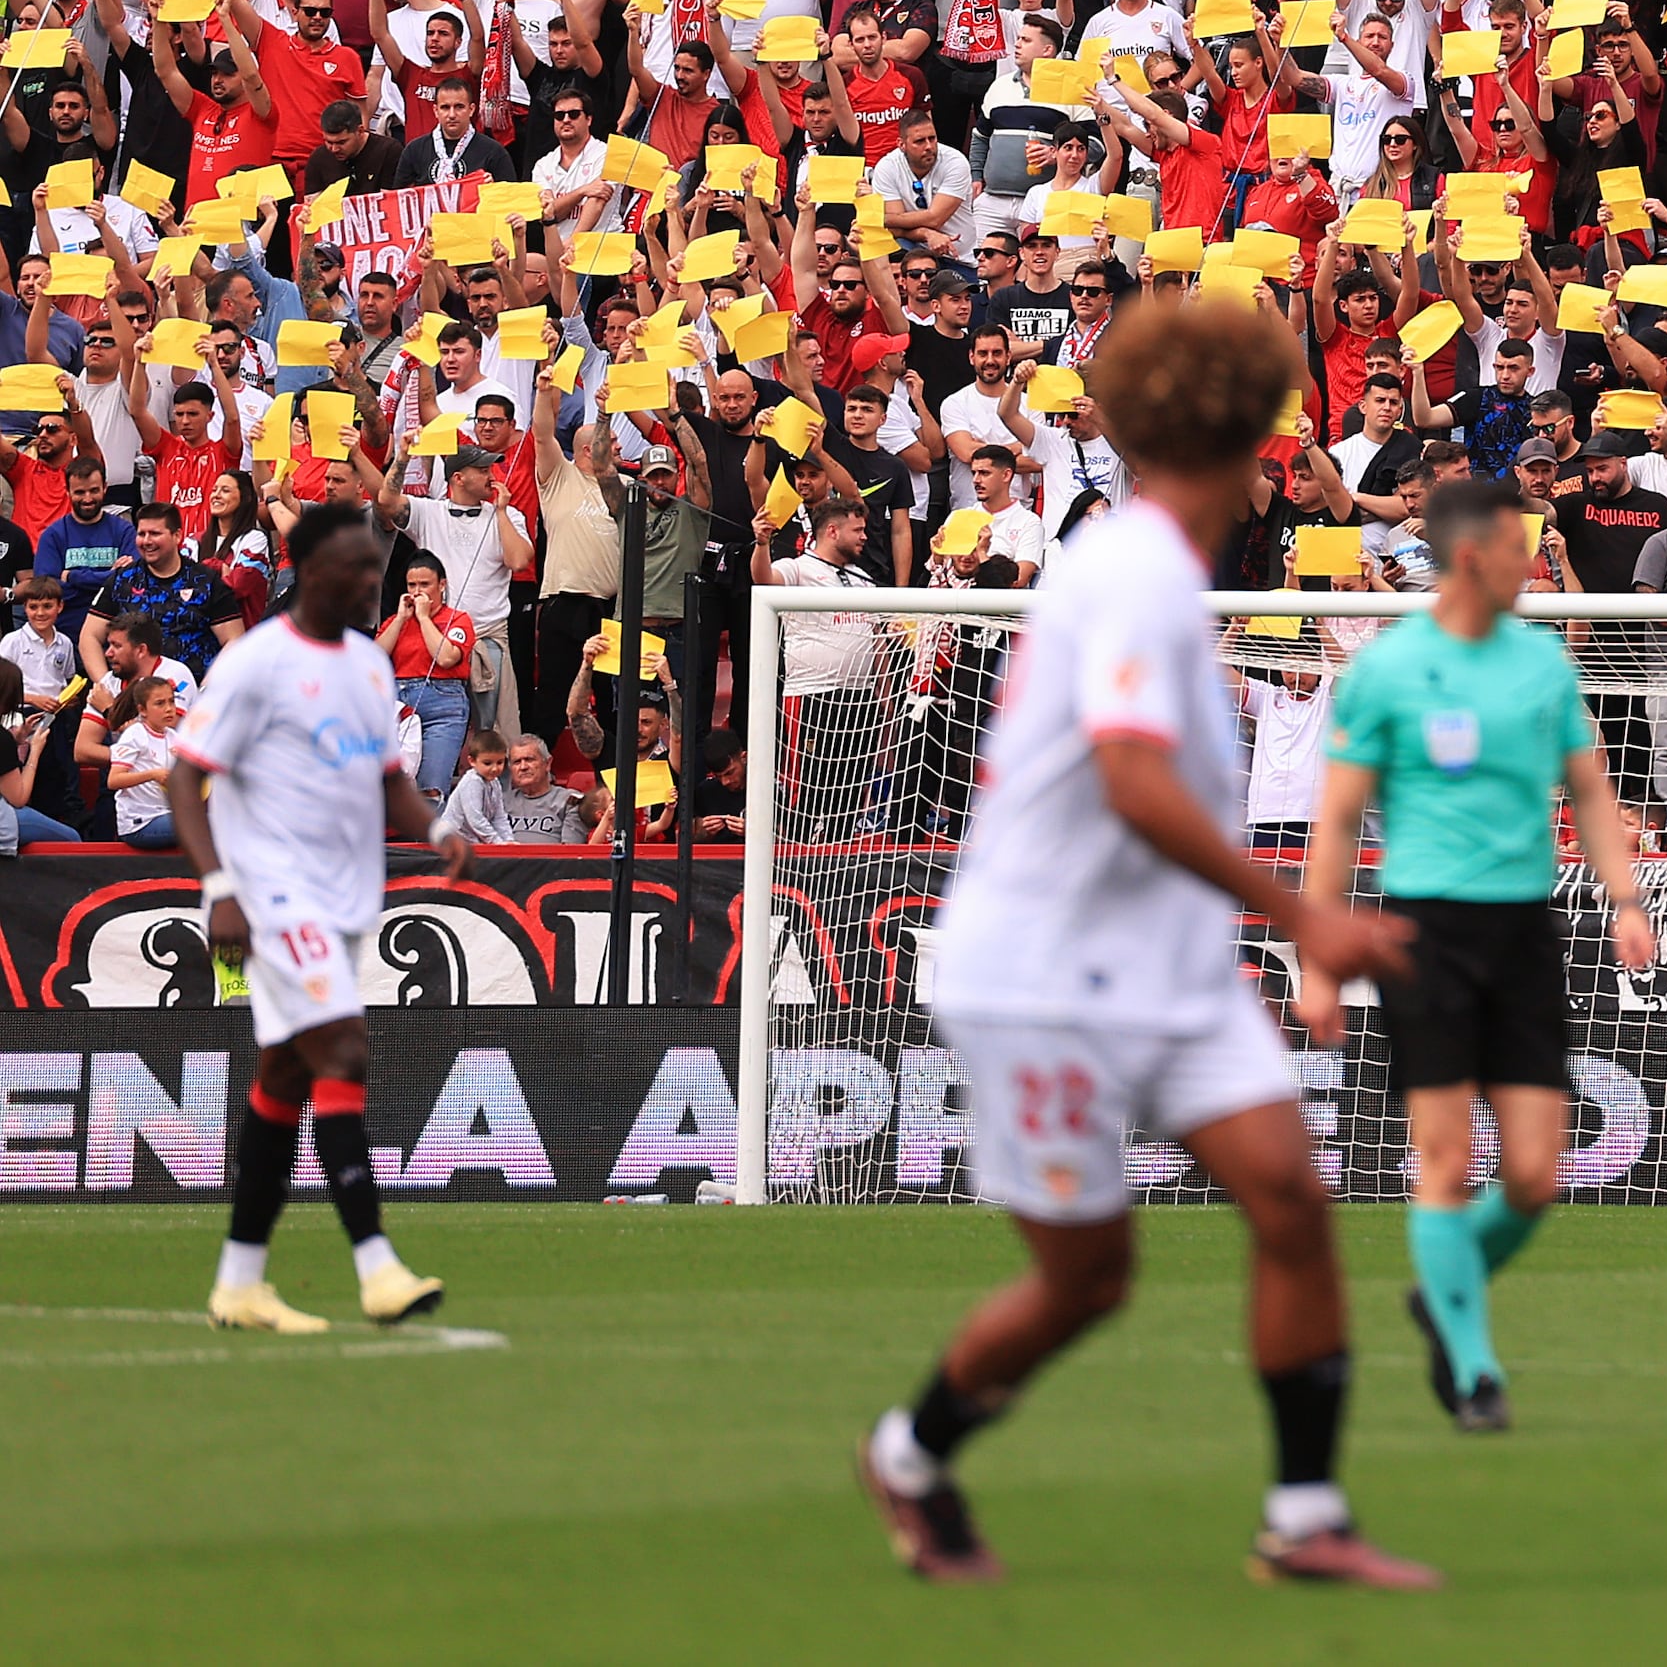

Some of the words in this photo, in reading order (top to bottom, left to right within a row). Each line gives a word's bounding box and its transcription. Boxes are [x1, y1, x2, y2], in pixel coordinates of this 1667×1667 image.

[194, 132, 240, 147] CAMPNES
[1010, 309, 1052, 319] TUJAMO
[1011, 319, 1034, 335] LET
[280, 920, 330, 968] 15
[1014, 1064, 1097, 1137] 22
